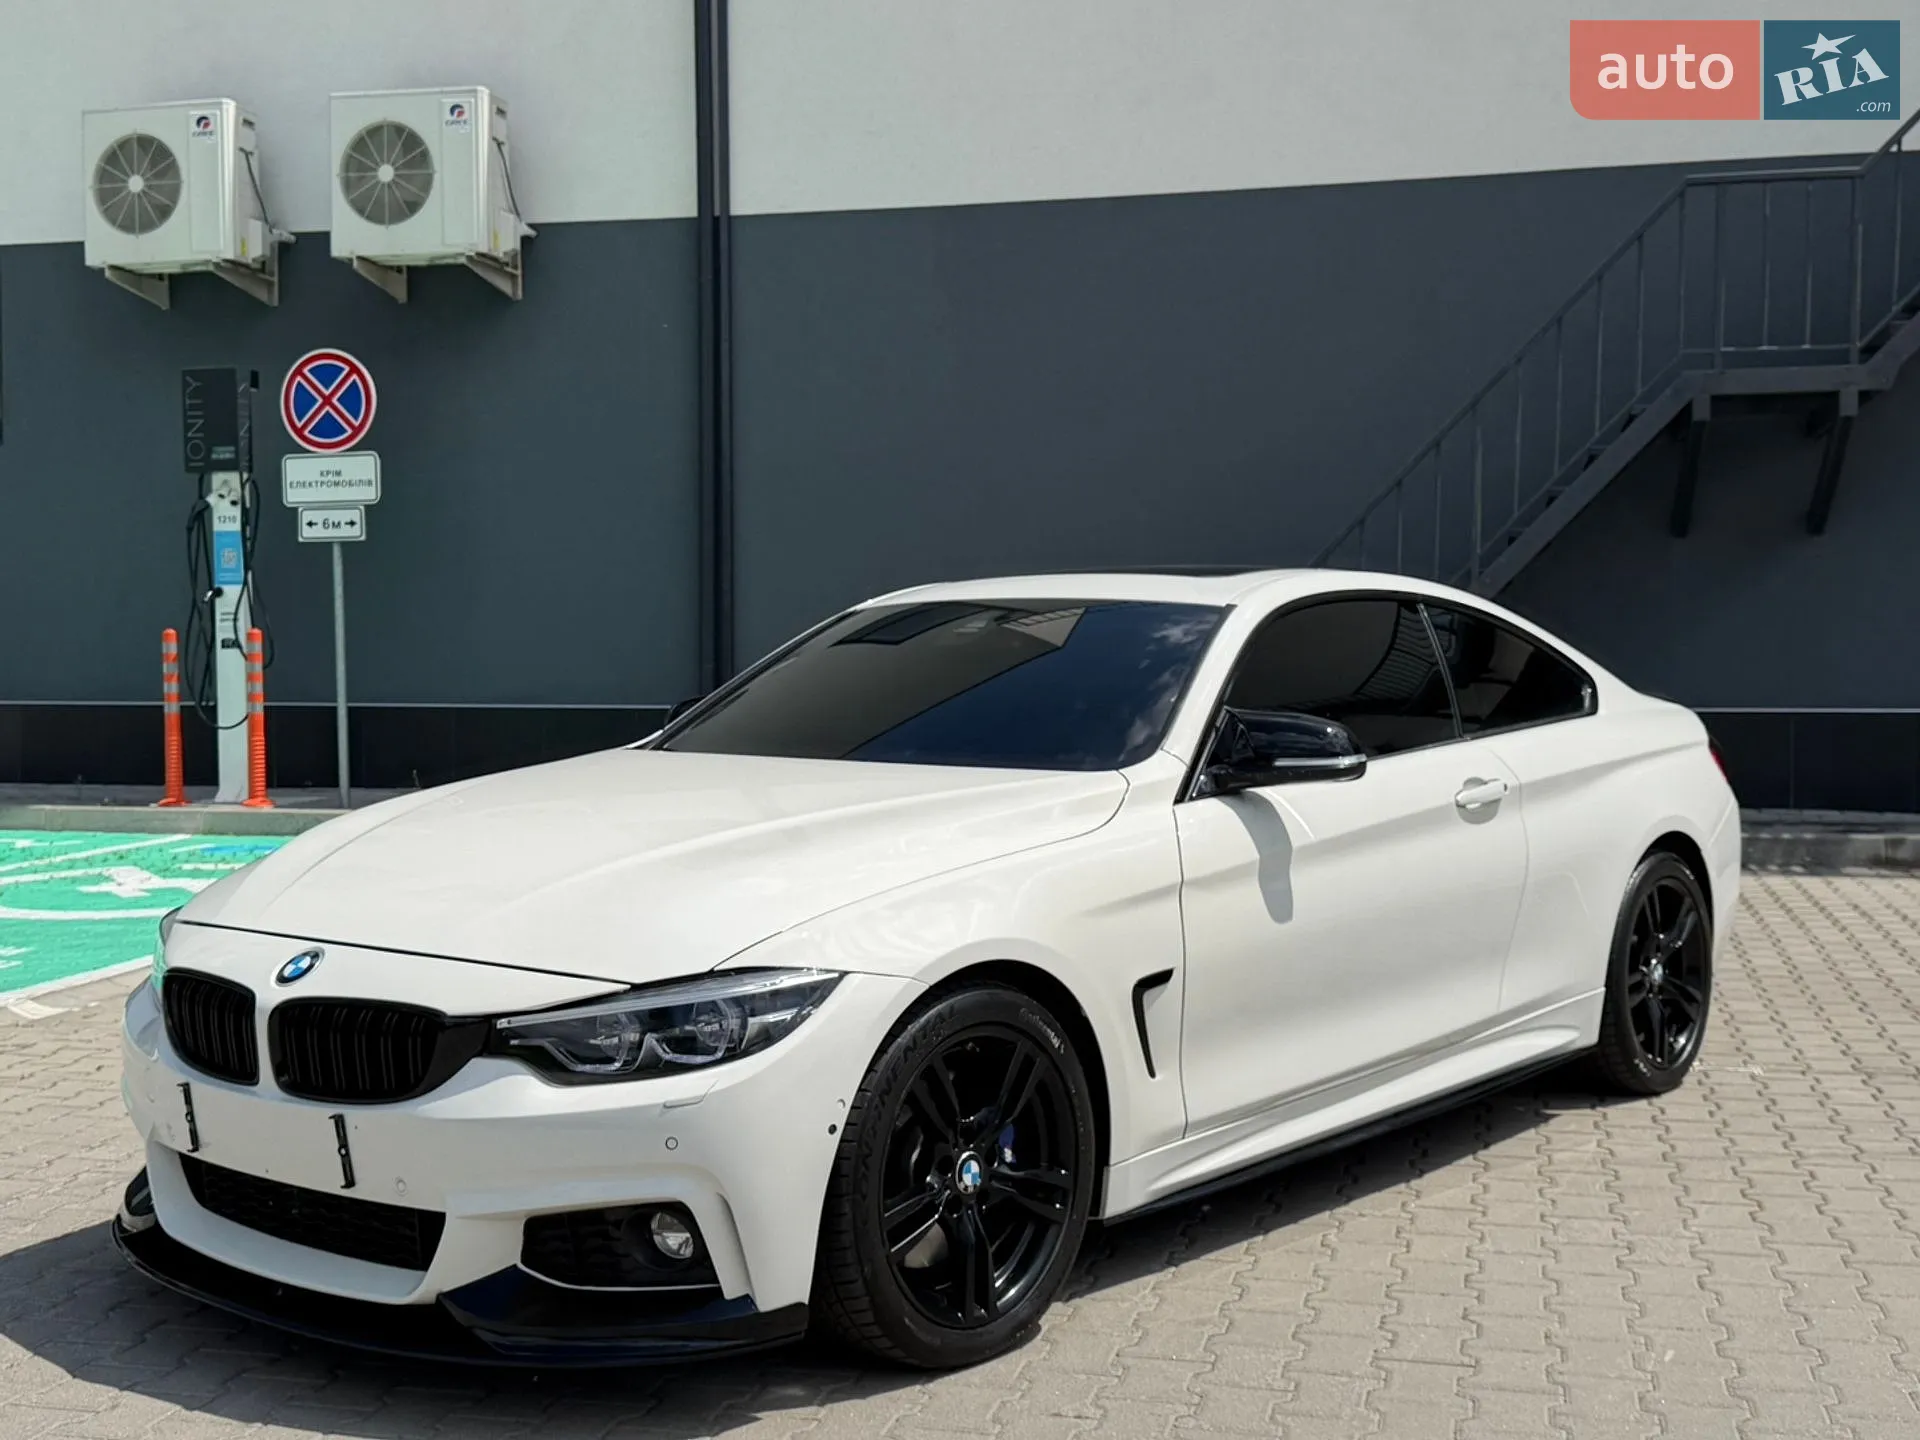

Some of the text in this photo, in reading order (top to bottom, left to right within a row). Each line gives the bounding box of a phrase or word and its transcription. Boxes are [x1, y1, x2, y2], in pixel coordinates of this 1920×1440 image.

[184, 375, 205, 468] IONITY
[319, 469, 342, 478] КРІМ
[217, 514, 238, 525] 1210
